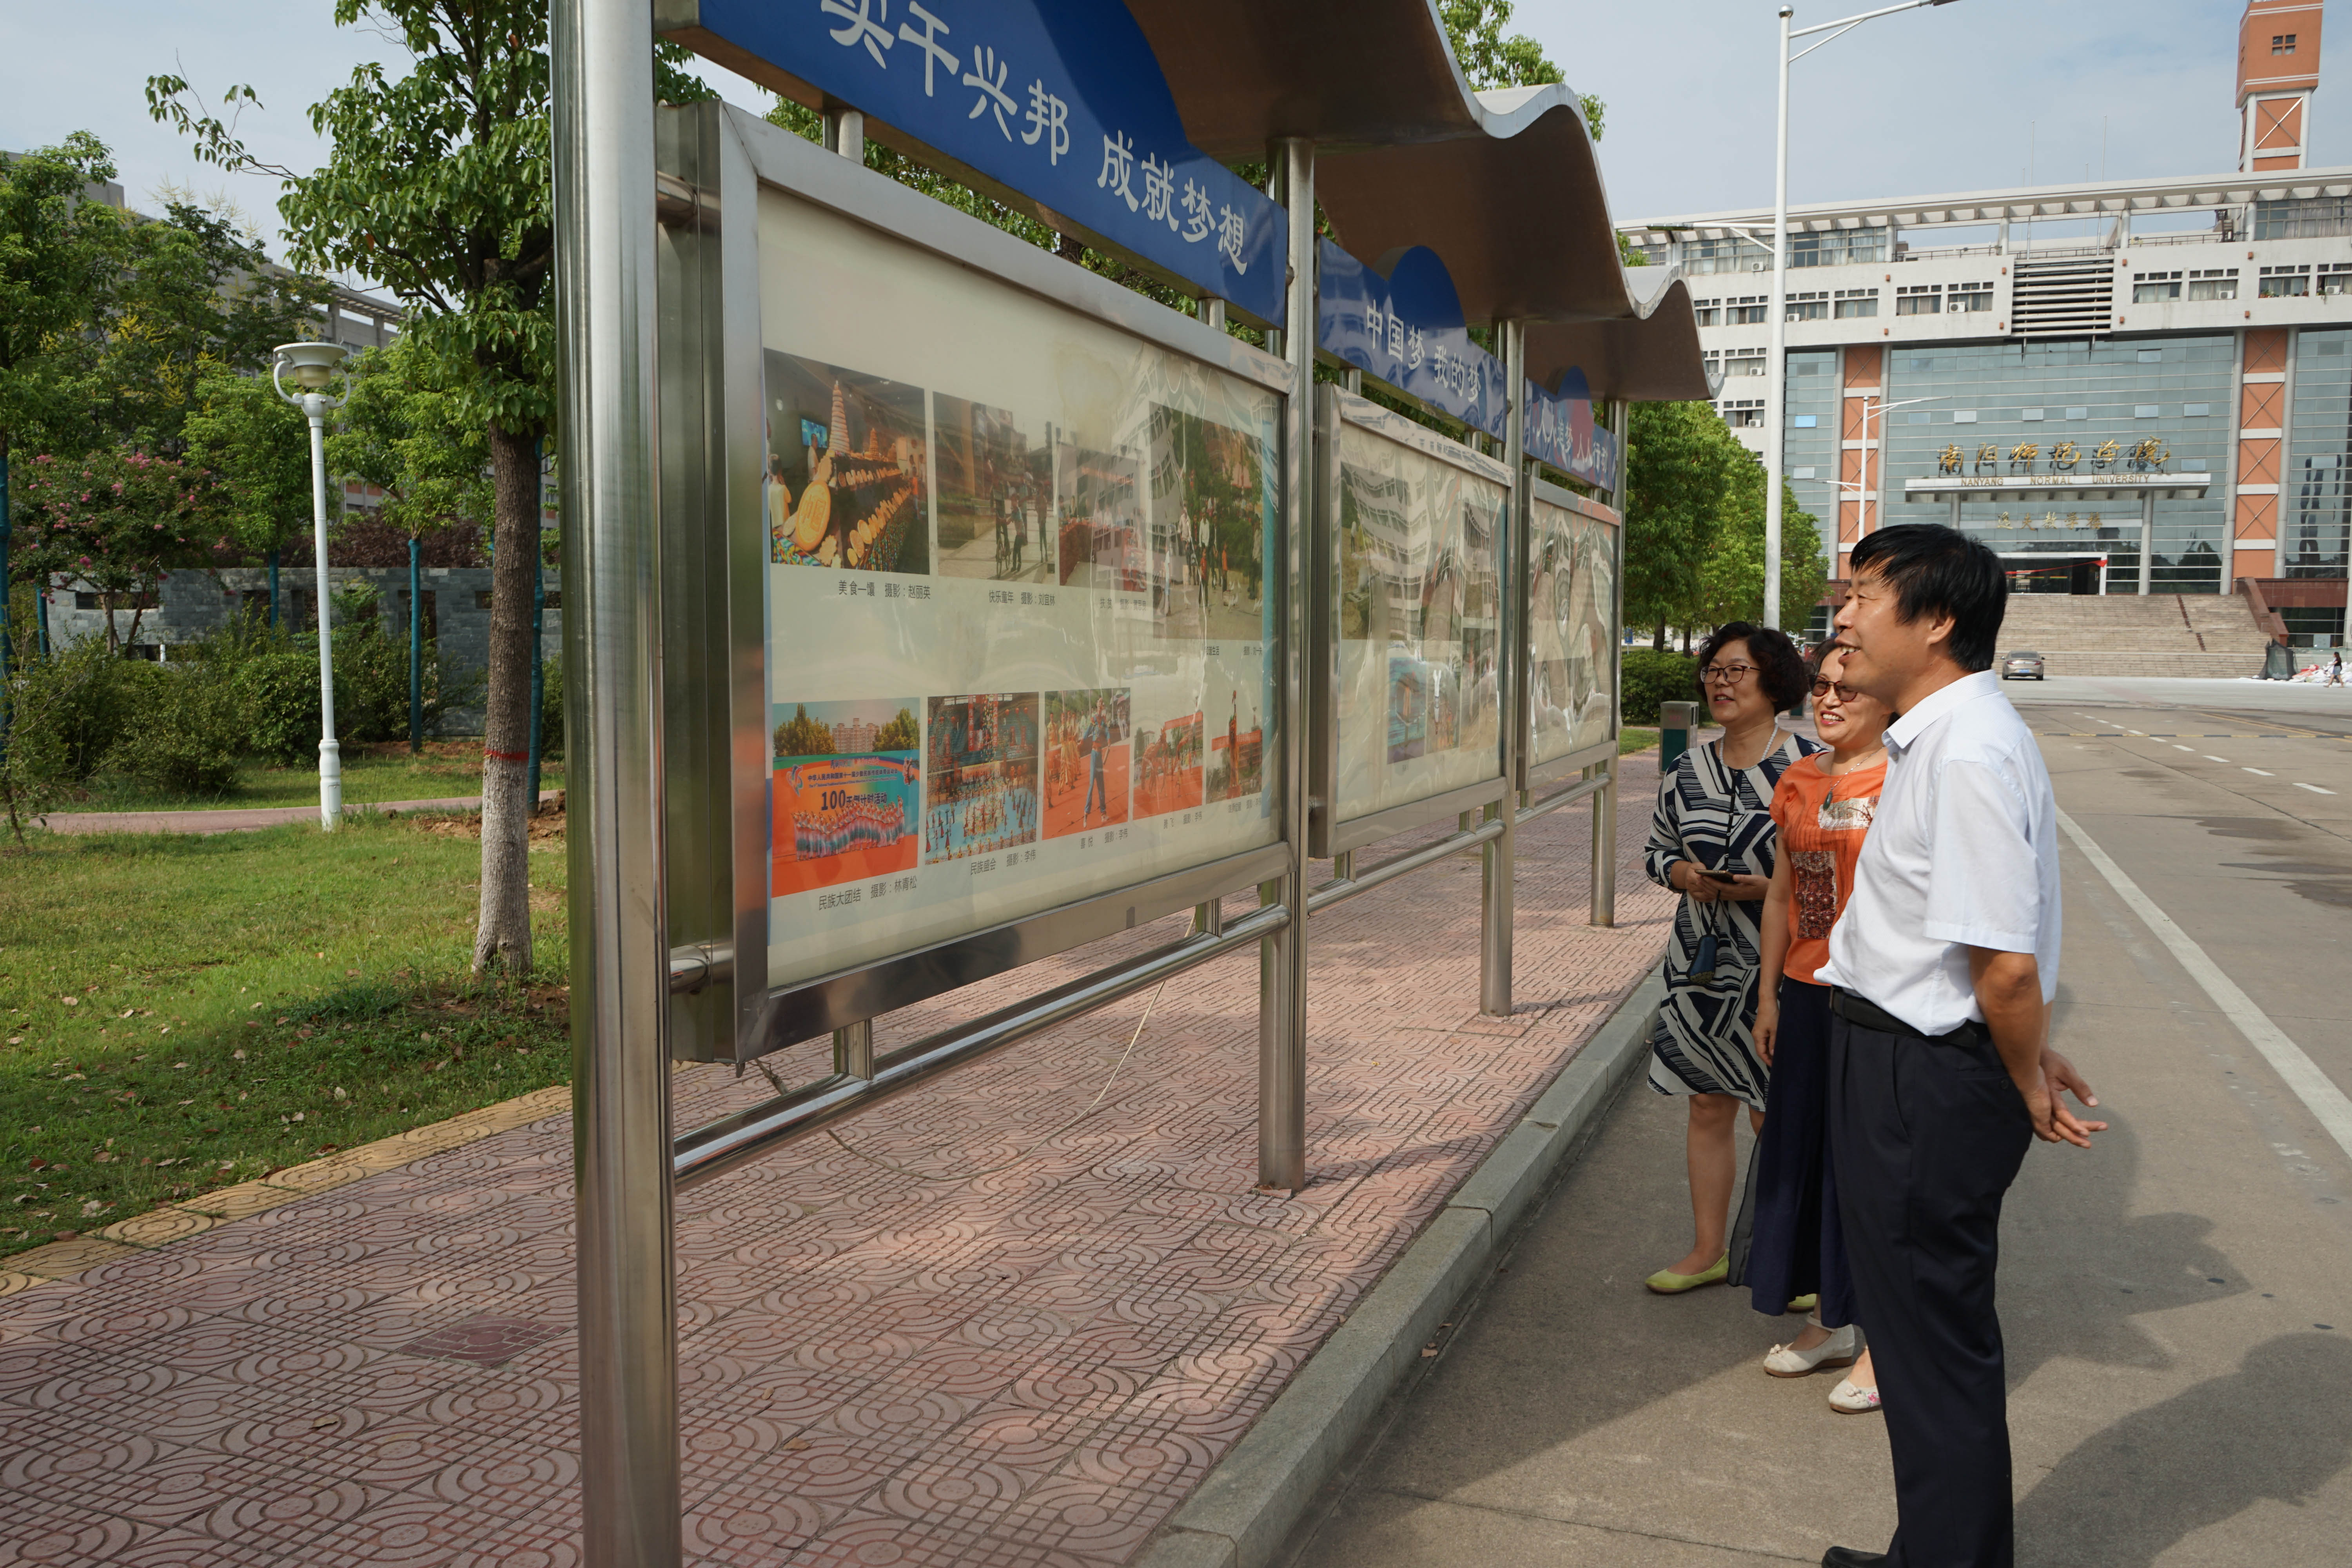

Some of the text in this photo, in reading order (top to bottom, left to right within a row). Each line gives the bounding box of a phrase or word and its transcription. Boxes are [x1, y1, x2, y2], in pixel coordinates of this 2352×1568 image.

[1097, 130, 1247, 275] 成就梦想
[1367, 299, 1481, 403] 中国梦 我的梦
[1536, 411, 1608, 473] 人人追梦 人人行动
[1938, 435, 2171, 472] 南阳师范学院
[1961, 474, 2150, 486] NANYANG NORMAL UNIVERSITY
[1998, 511, 2103, 531] 逸夫教学楼
[885, 583, 931, 599] 摄影：赵丽英
[989, 590, 1014, 604] 快乐童年
[970, 849, 1036, 875] 民族盛会 摄影：李伟
[818, 875, 917, 911] 民族大团结 摄影：林青松
